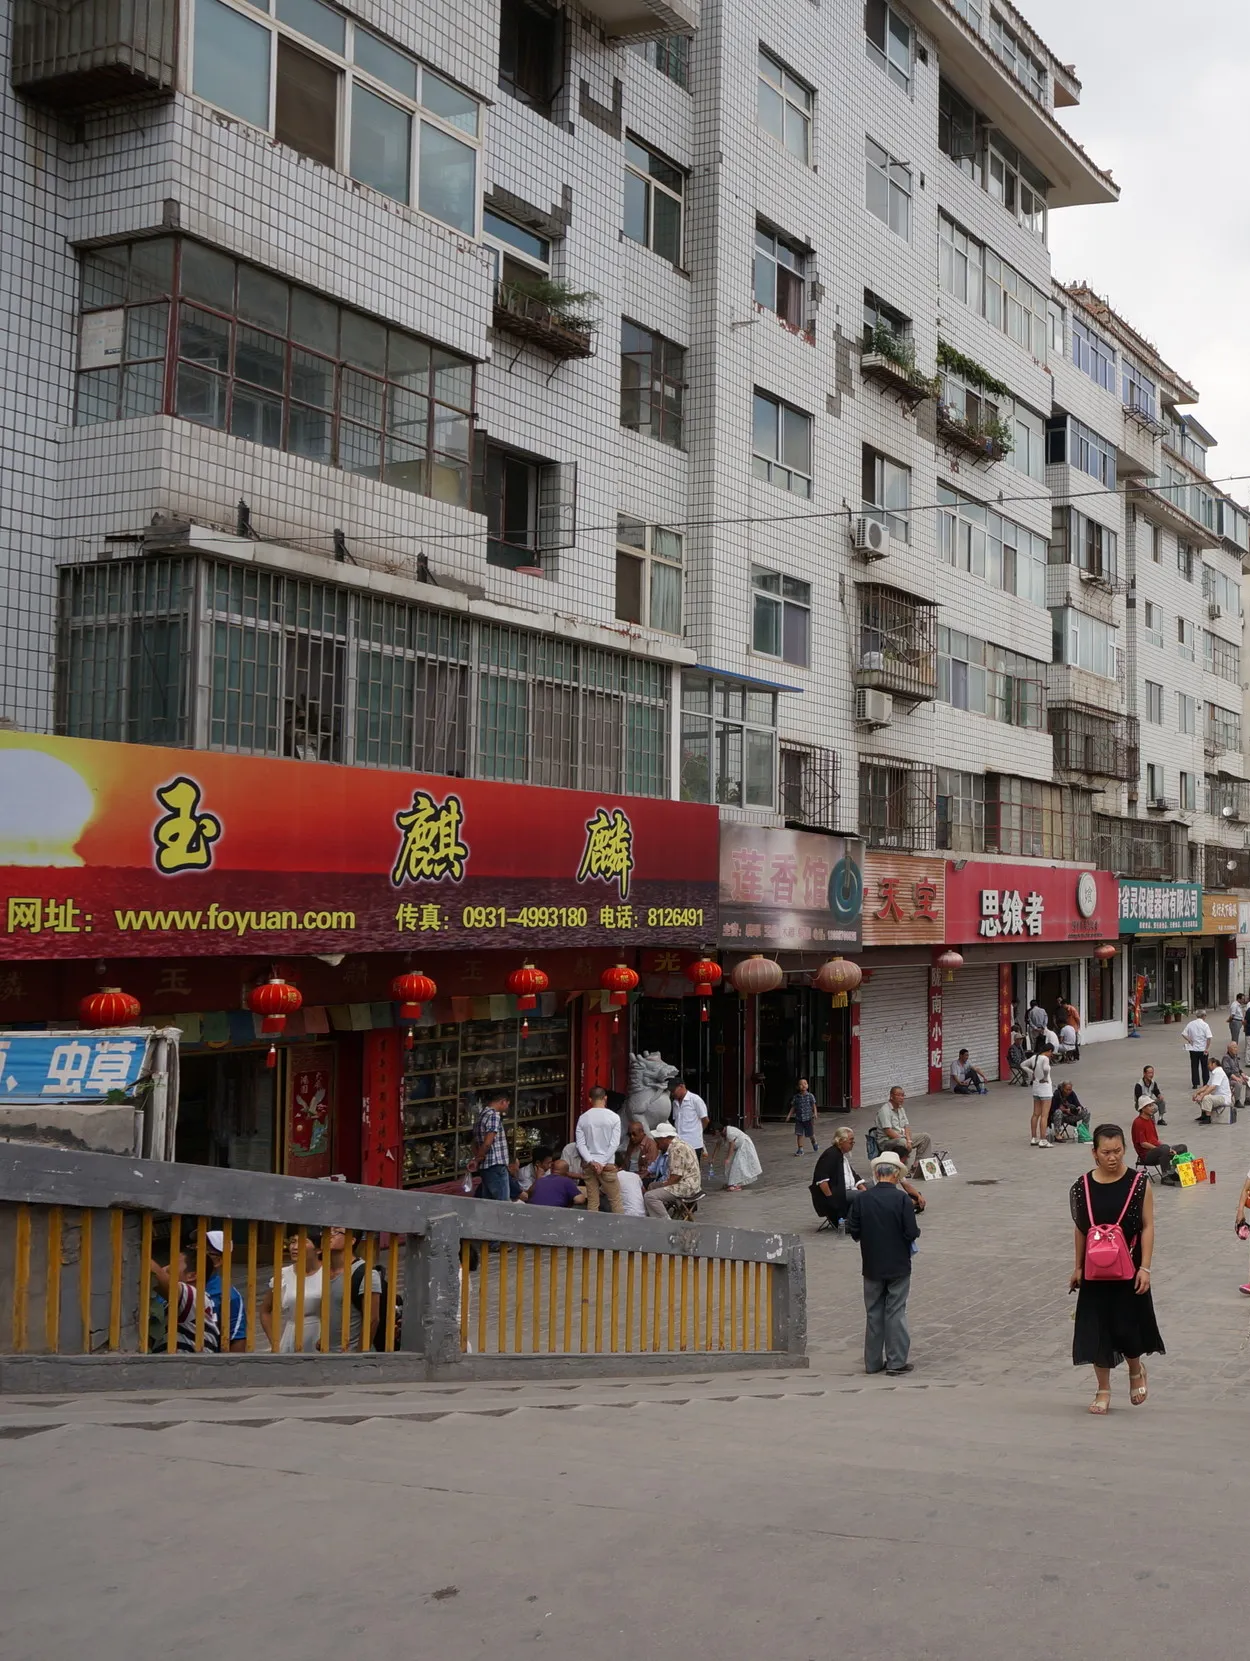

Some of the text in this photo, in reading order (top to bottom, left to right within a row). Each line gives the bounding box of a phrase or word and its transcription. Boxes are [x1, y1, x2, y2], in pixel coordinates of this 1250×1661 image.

[730, 848, 831, 909] 莲香馆
[863, 876, 939, 920] 天宝
[1118, 884, 1198, 920] 省灵保健器械有限公司
[114, 903, 356, 936] www.foyuan.com
[647, 907, 704, 927] 8126491
[654, 952, 681, 972] 光
[0, 1040, 137, 1095] 、虫草
